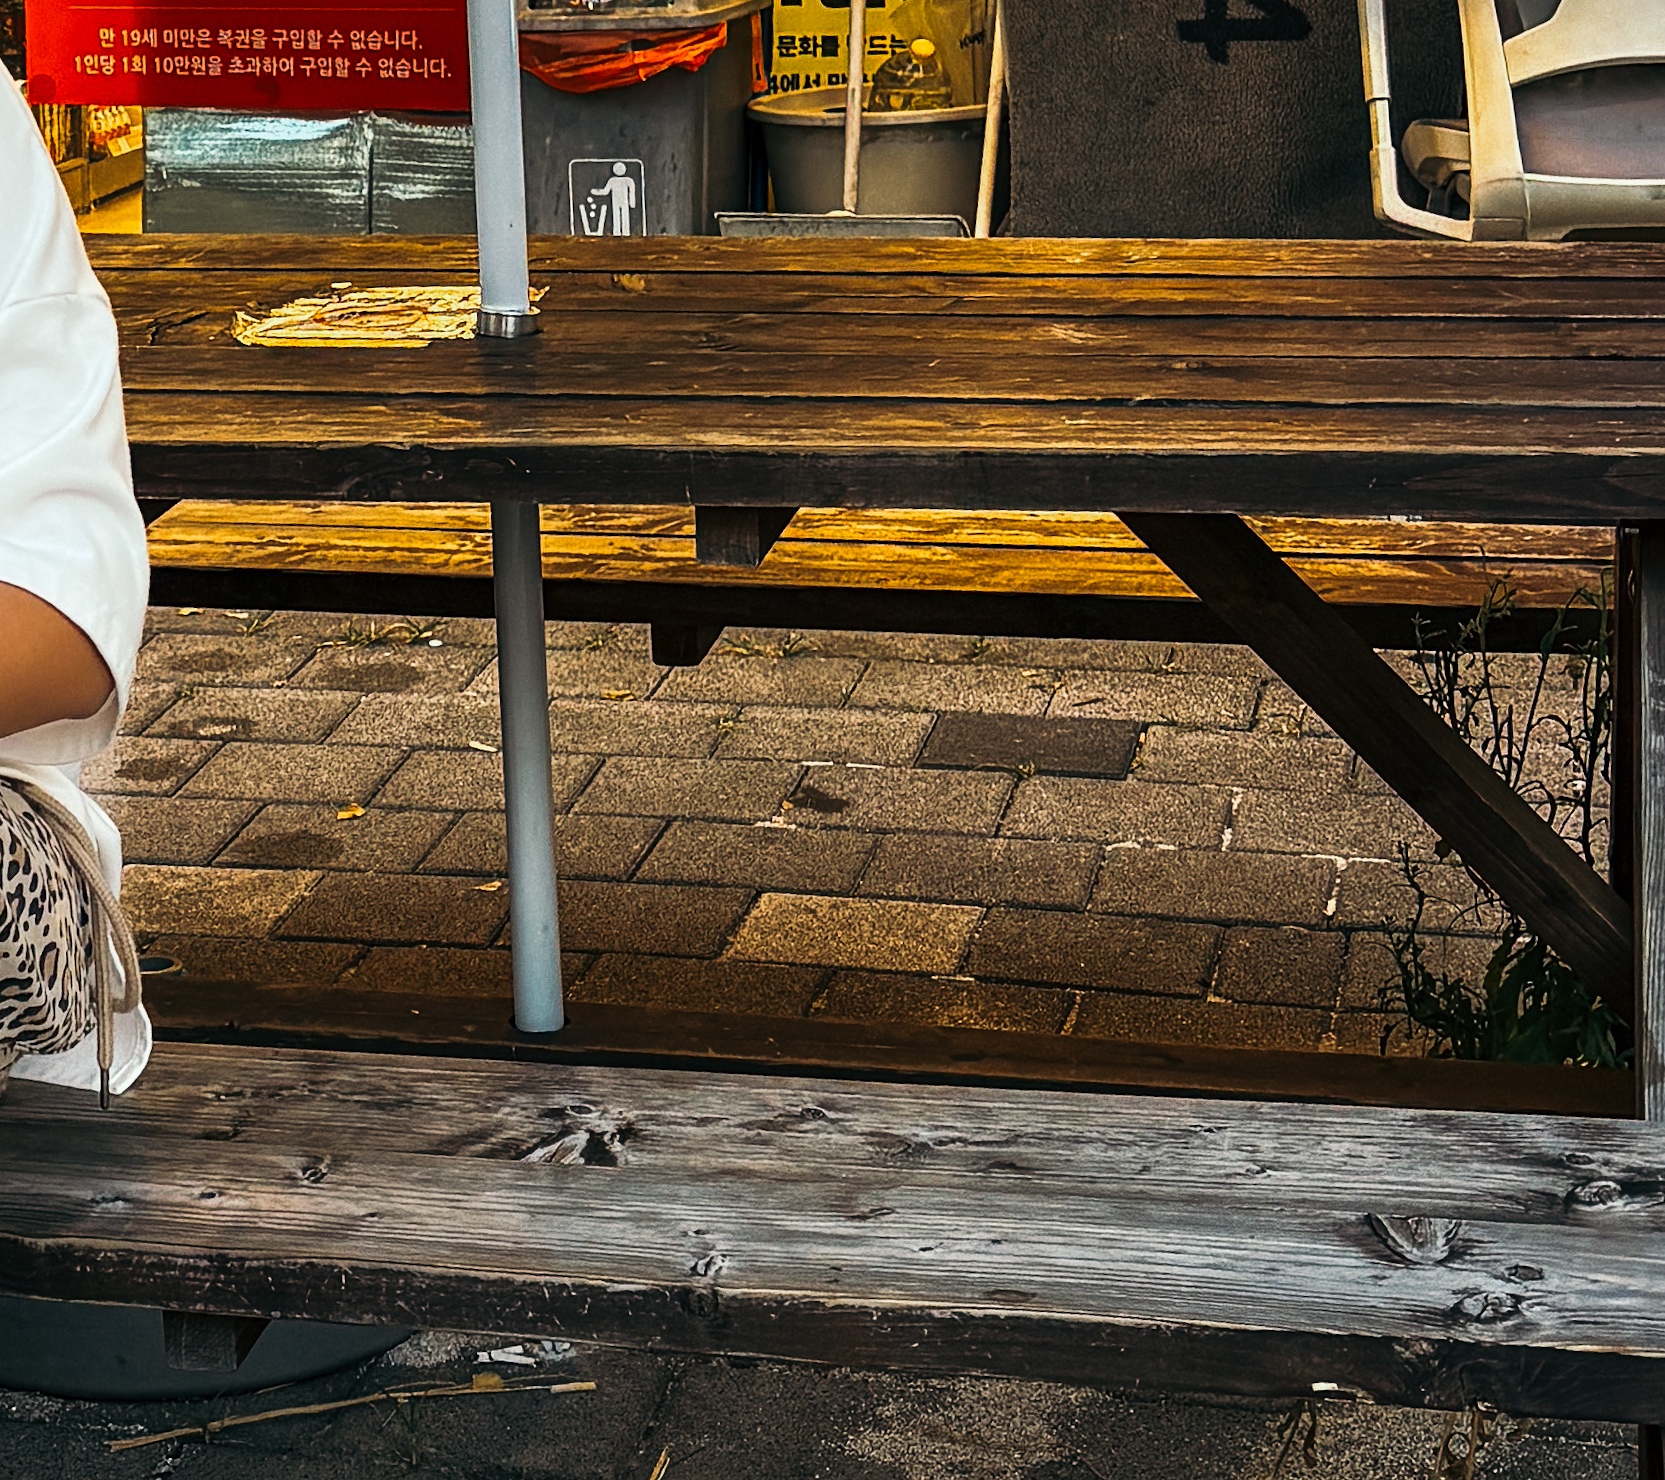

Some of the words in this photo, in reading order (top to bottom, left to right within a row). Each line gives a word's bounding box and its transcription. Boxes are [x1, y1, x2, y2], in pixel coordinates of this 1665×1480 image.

[98, 29, 116, 48] 만
[121, 28, 157, 48] 19세
[163, 28, 213, 49] 미만은
[217, 29, 268, 50] 복권을
[272, 29, 323, 50] 구입할
[327, 29, 344, 50] 수
[349, 29, 423, 51] 없습니다.
[777, 35, 840, 58] 문화를
[75, 55, 115, 75] 1인당
[122, 55, 147, 75] 1회
[155, 55, 222, 76] 10만원을
[228, 56, 294, 78] 초과하여
[299, 56, 351, 78] 구입할
[355, 57, 372, 78] 수
[378, 57, 452, 79] 없습니다.
